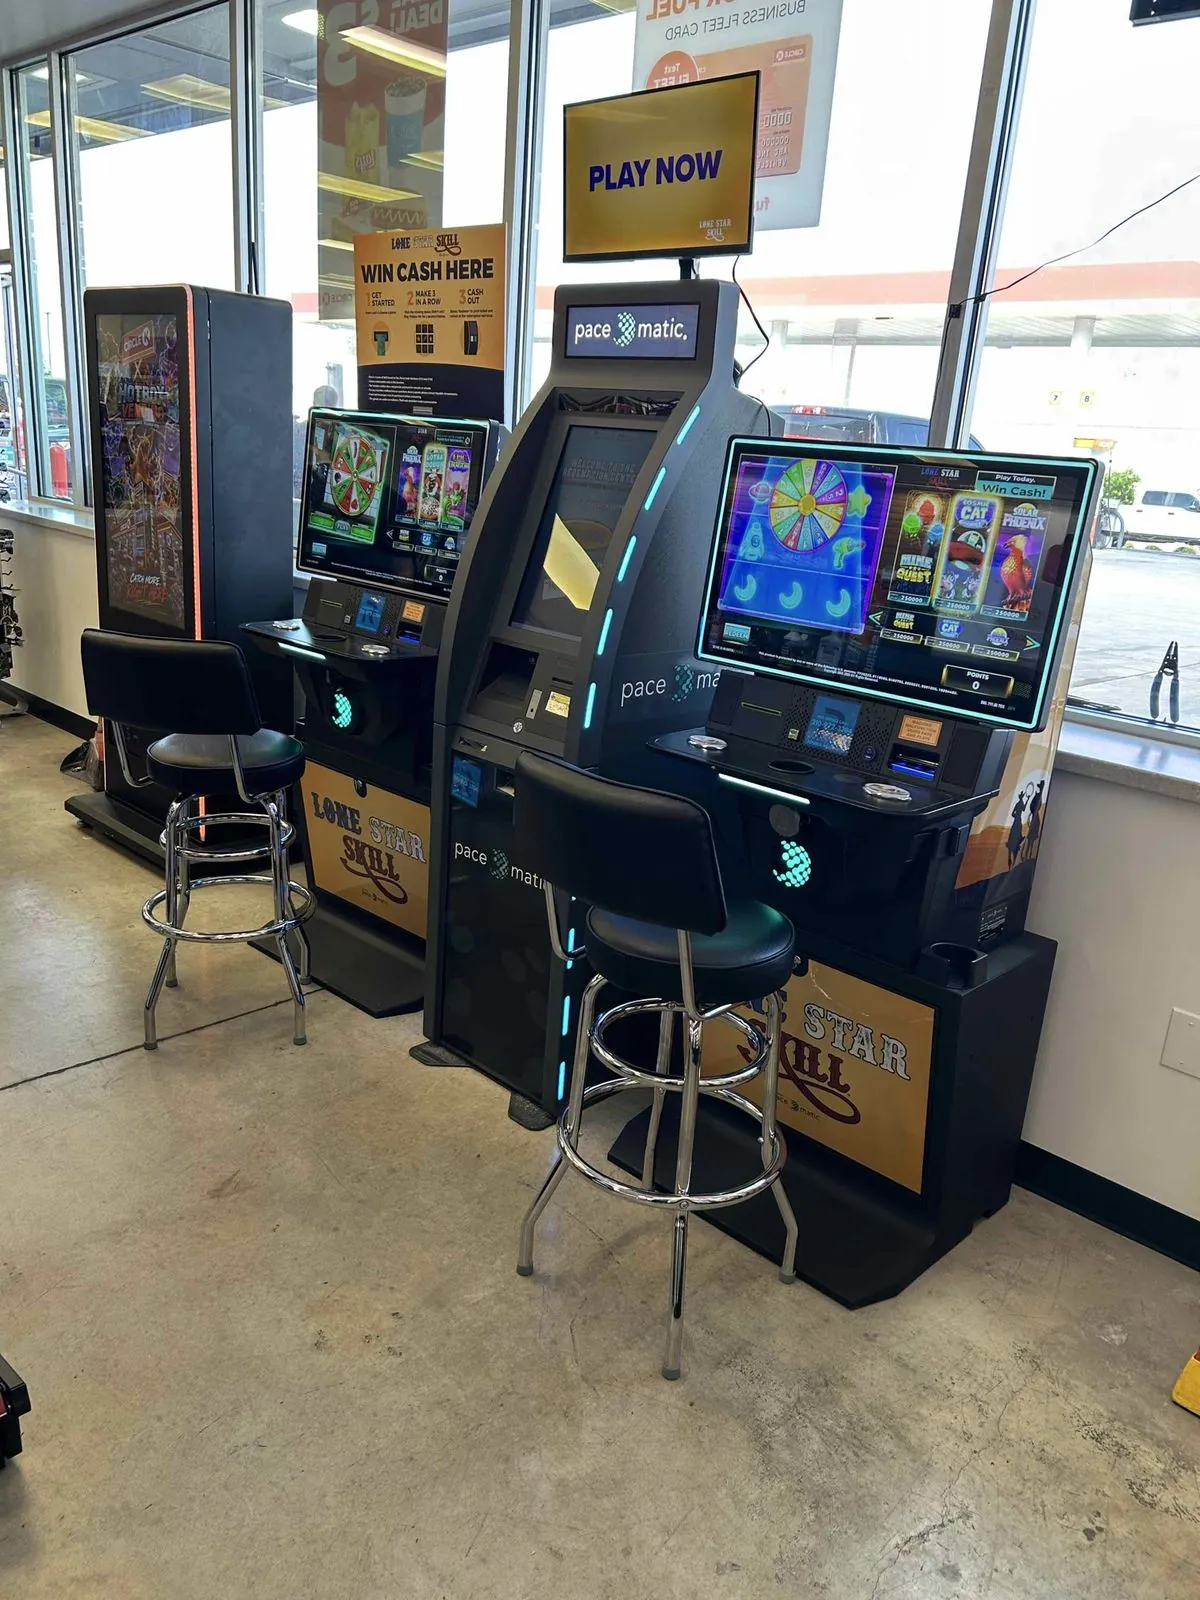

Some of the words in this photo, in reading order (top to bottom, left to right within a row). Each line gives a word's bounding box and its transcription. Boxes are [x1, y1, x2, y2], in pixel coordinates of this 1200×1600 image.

[589, 159, 651, 192] PLAY
[656, 150, 723, 185] NOW
[699, 219, 714, 229] LONE
[715, 218, 732, 228] STAR
[705, 228, 724, 239] SKILL
[391, 237, 411, 250] LONE
[435, 234, 460, 252] SKILL
[361, 263, 394, 283] WIN
[397, 260, 442, 282] CASH
[446, 258, 494, 281] HERE
[372, 291, 382, 299] GET
[407, 291, 414, 306] 2
[415, 290, 431, 298] MAKE
[459, 289, 467, 305] 3
[467, 288, 484, 296] CASH
[467, 297, 480, 305] OUT
[574, 322, 612, 345] pace
[941, 468, 960, 478] STAR
[995, 474, 1012, 482] Play
[1013, 475, 1036, 484] Today.
[983, 484, 1007, 495] Win
[1011, 486, 1046, 498] Cash!
[961, 506, 988, 520] CAT
[1013, 507, 1039, 518] SOLAR
[1002, 513, 1047, 530] PHOENIX
[900, 554, 933, 568] MINE
[896, 567, 931, 584] QUEST
[941, 623, 959, 632] CAT
[967, 671, 989, 680] POINTS
[972, 681, 980, 690] 0
[620, 678, 666, 708] pace
[311, 791, 362, 835] LONE
[369, 815, 427, 864] STAR
[454, 842, 488, 865] pace
[341, 834, 404, 896] SKILL
[804, 1002, 911, 1081] STAR
